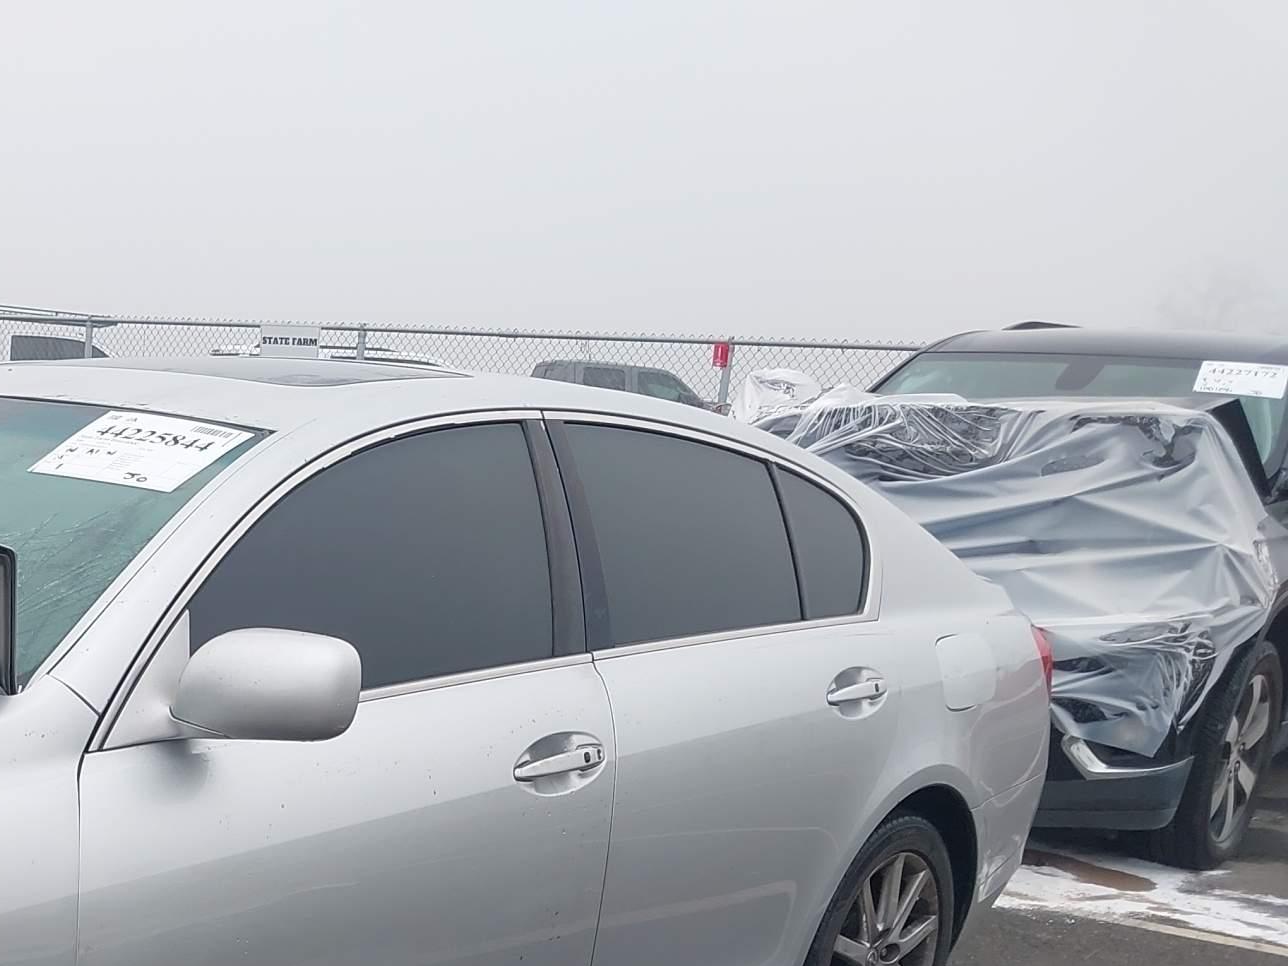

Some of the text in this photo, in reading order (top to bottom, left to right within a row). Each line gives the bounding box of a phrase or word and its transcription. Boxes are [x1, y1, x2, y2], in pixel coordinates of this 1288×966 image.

[262, 336, 318, 346] STATE FARM
[96, 425, 215, 452] 44225844
